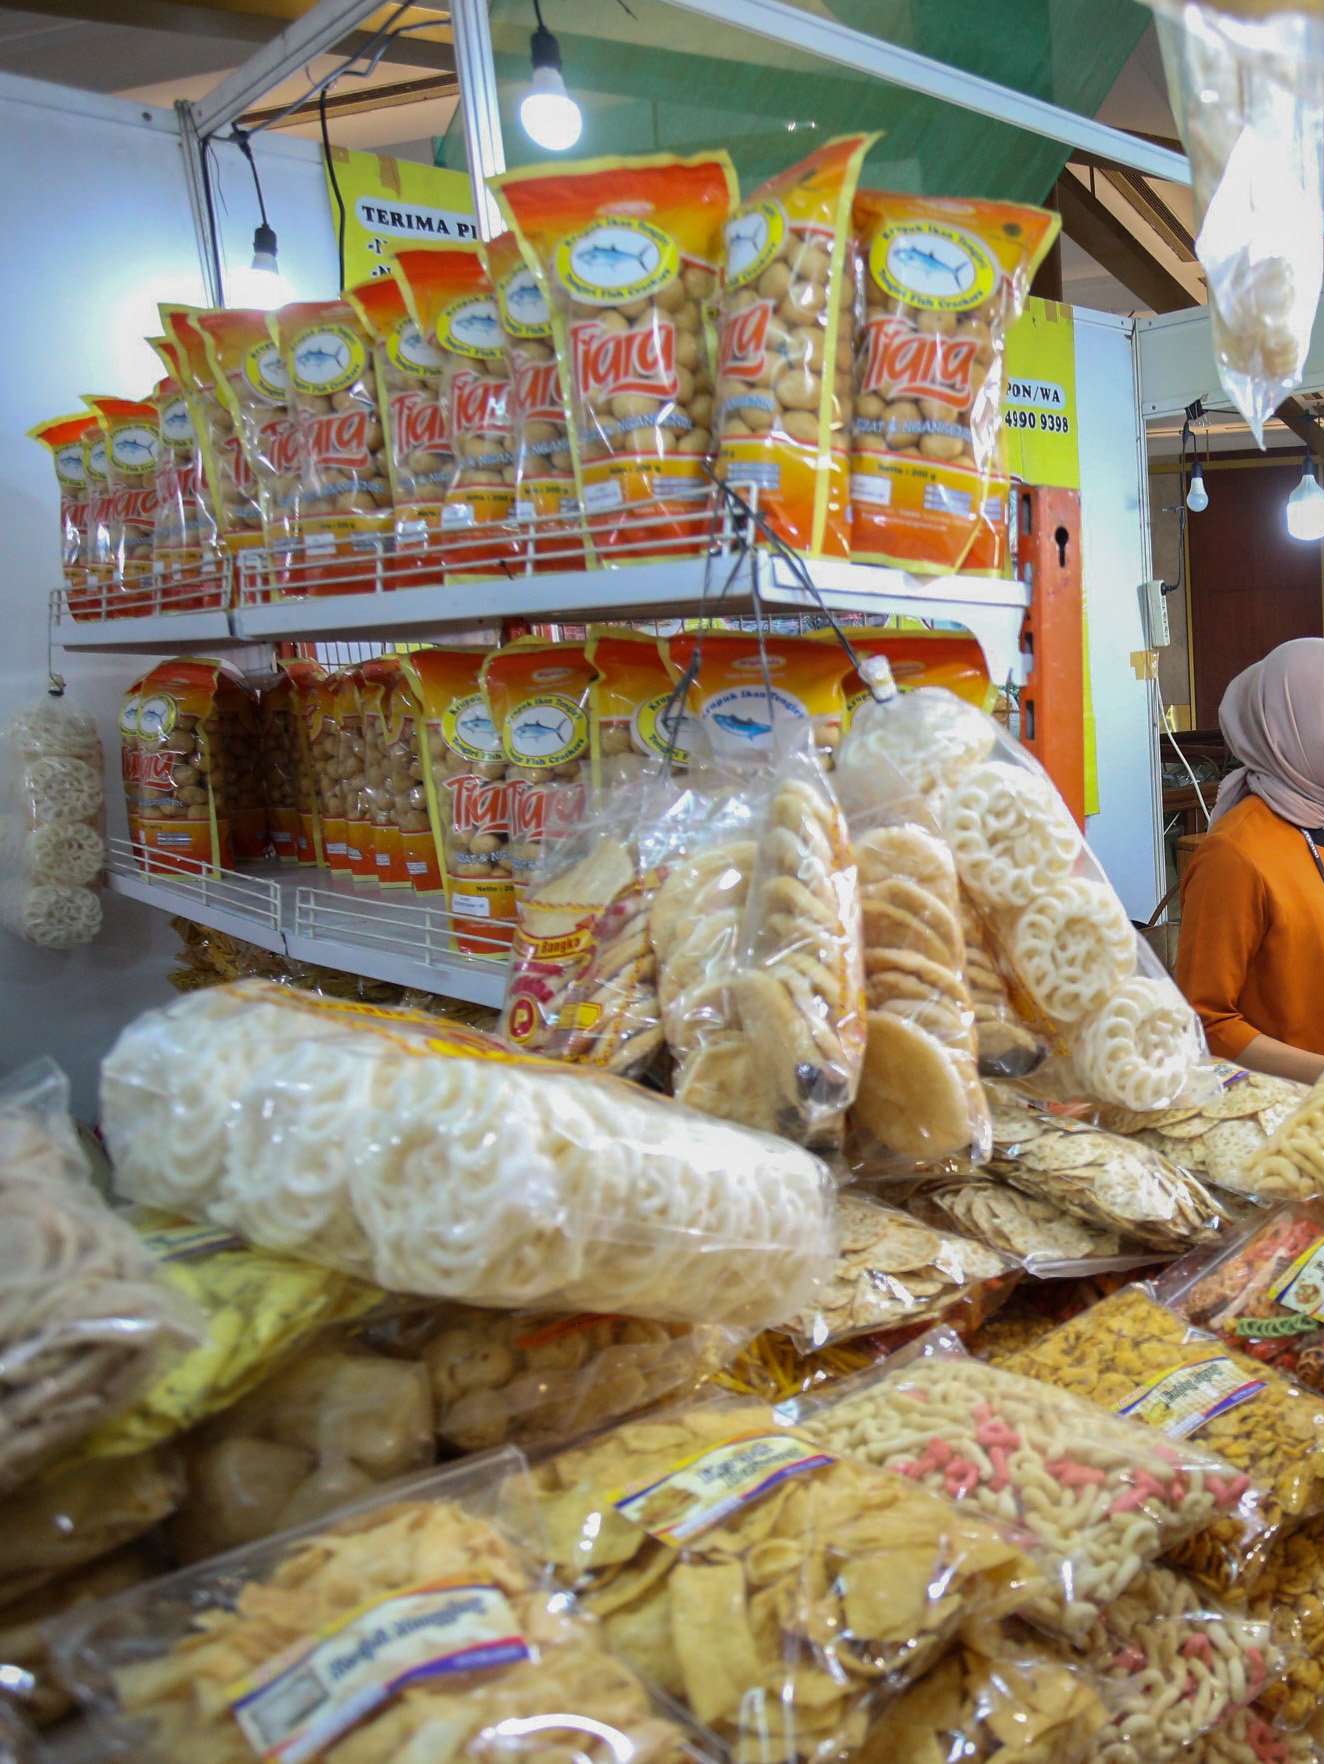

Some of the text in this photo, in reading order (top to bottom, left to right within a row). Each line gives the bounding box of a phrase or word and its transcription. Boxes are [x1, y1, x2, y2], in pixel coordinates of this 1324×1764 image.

[361, 205, 451, 235] TERIMA
[864, 317, 977, 395] Tiara
[1005, 409, 1069, 434] 4990 9398
[740, 689, 766, 699] Ikan
[524, 756, 547, 767] Fish
